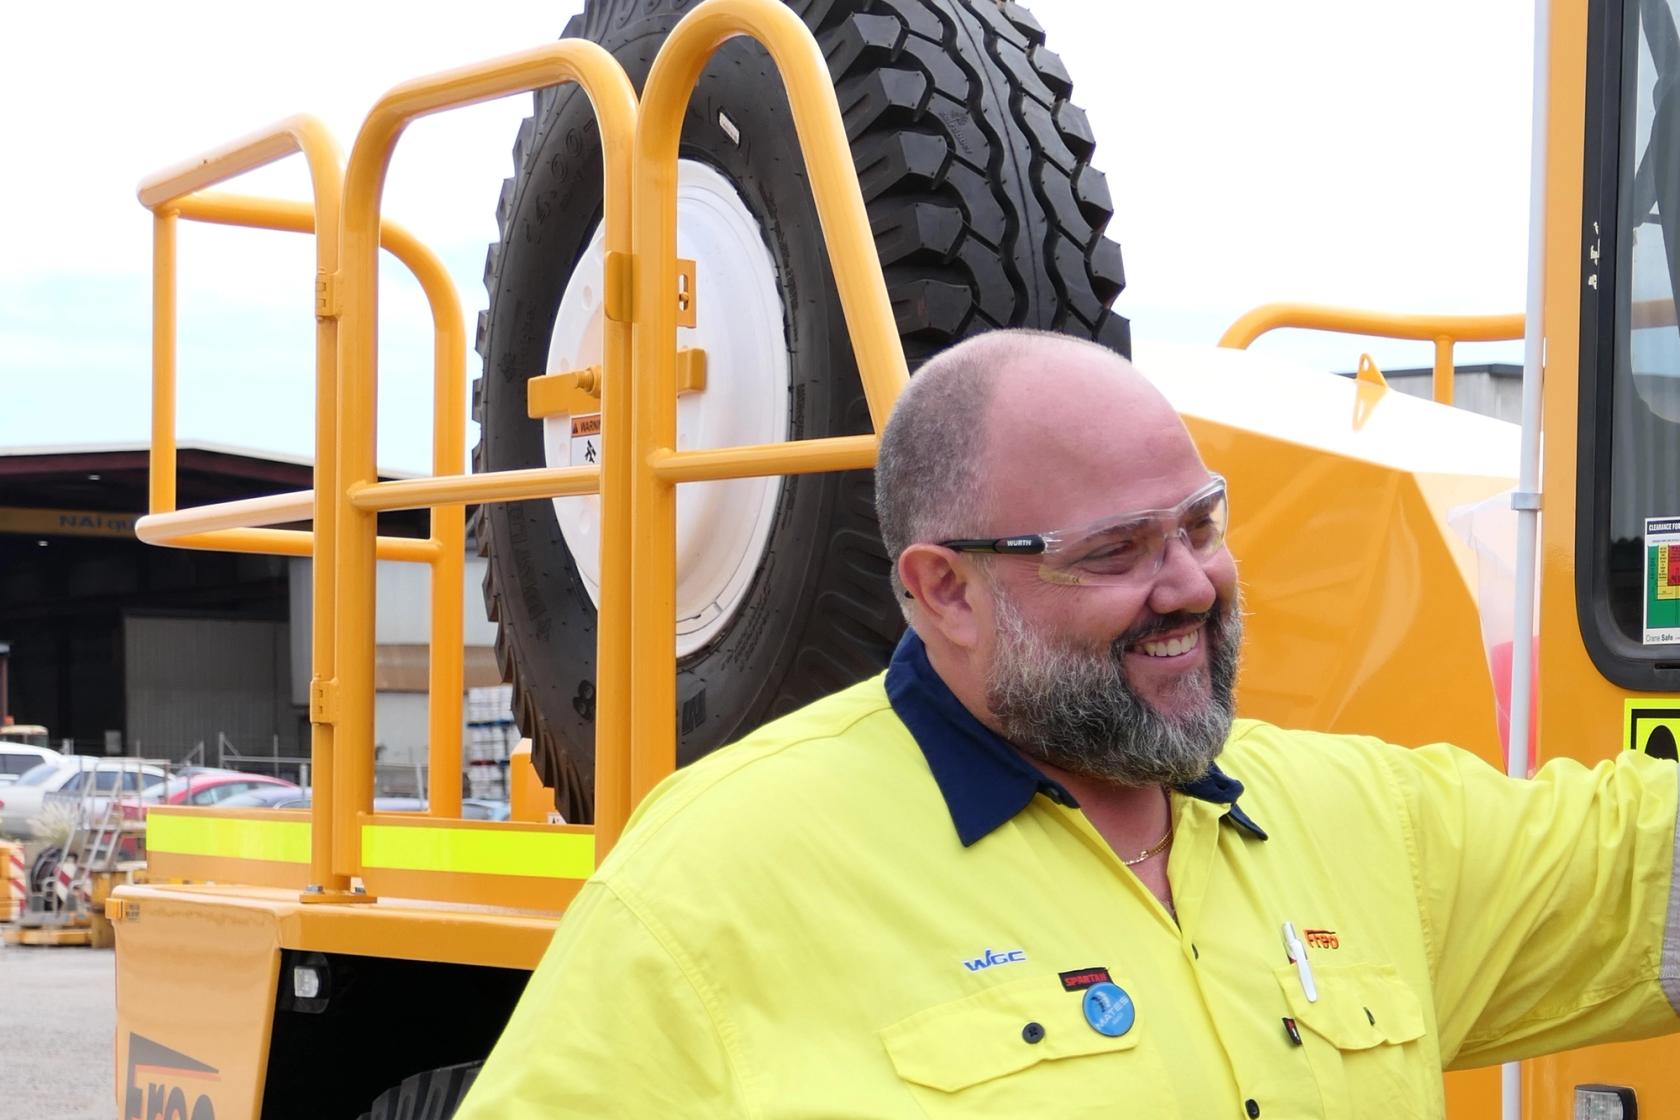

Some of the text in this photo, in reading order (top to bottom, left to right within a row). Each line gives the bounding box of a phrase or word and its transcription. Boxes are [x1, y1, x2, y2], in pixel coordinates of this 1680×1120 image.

[580, 420, 600, 433] WARN
[1648, 523, 1672, 531] CLEARANCE
[1672, 522, 1680, 530] FOR
[963, 948, 1027, 973] WGC
